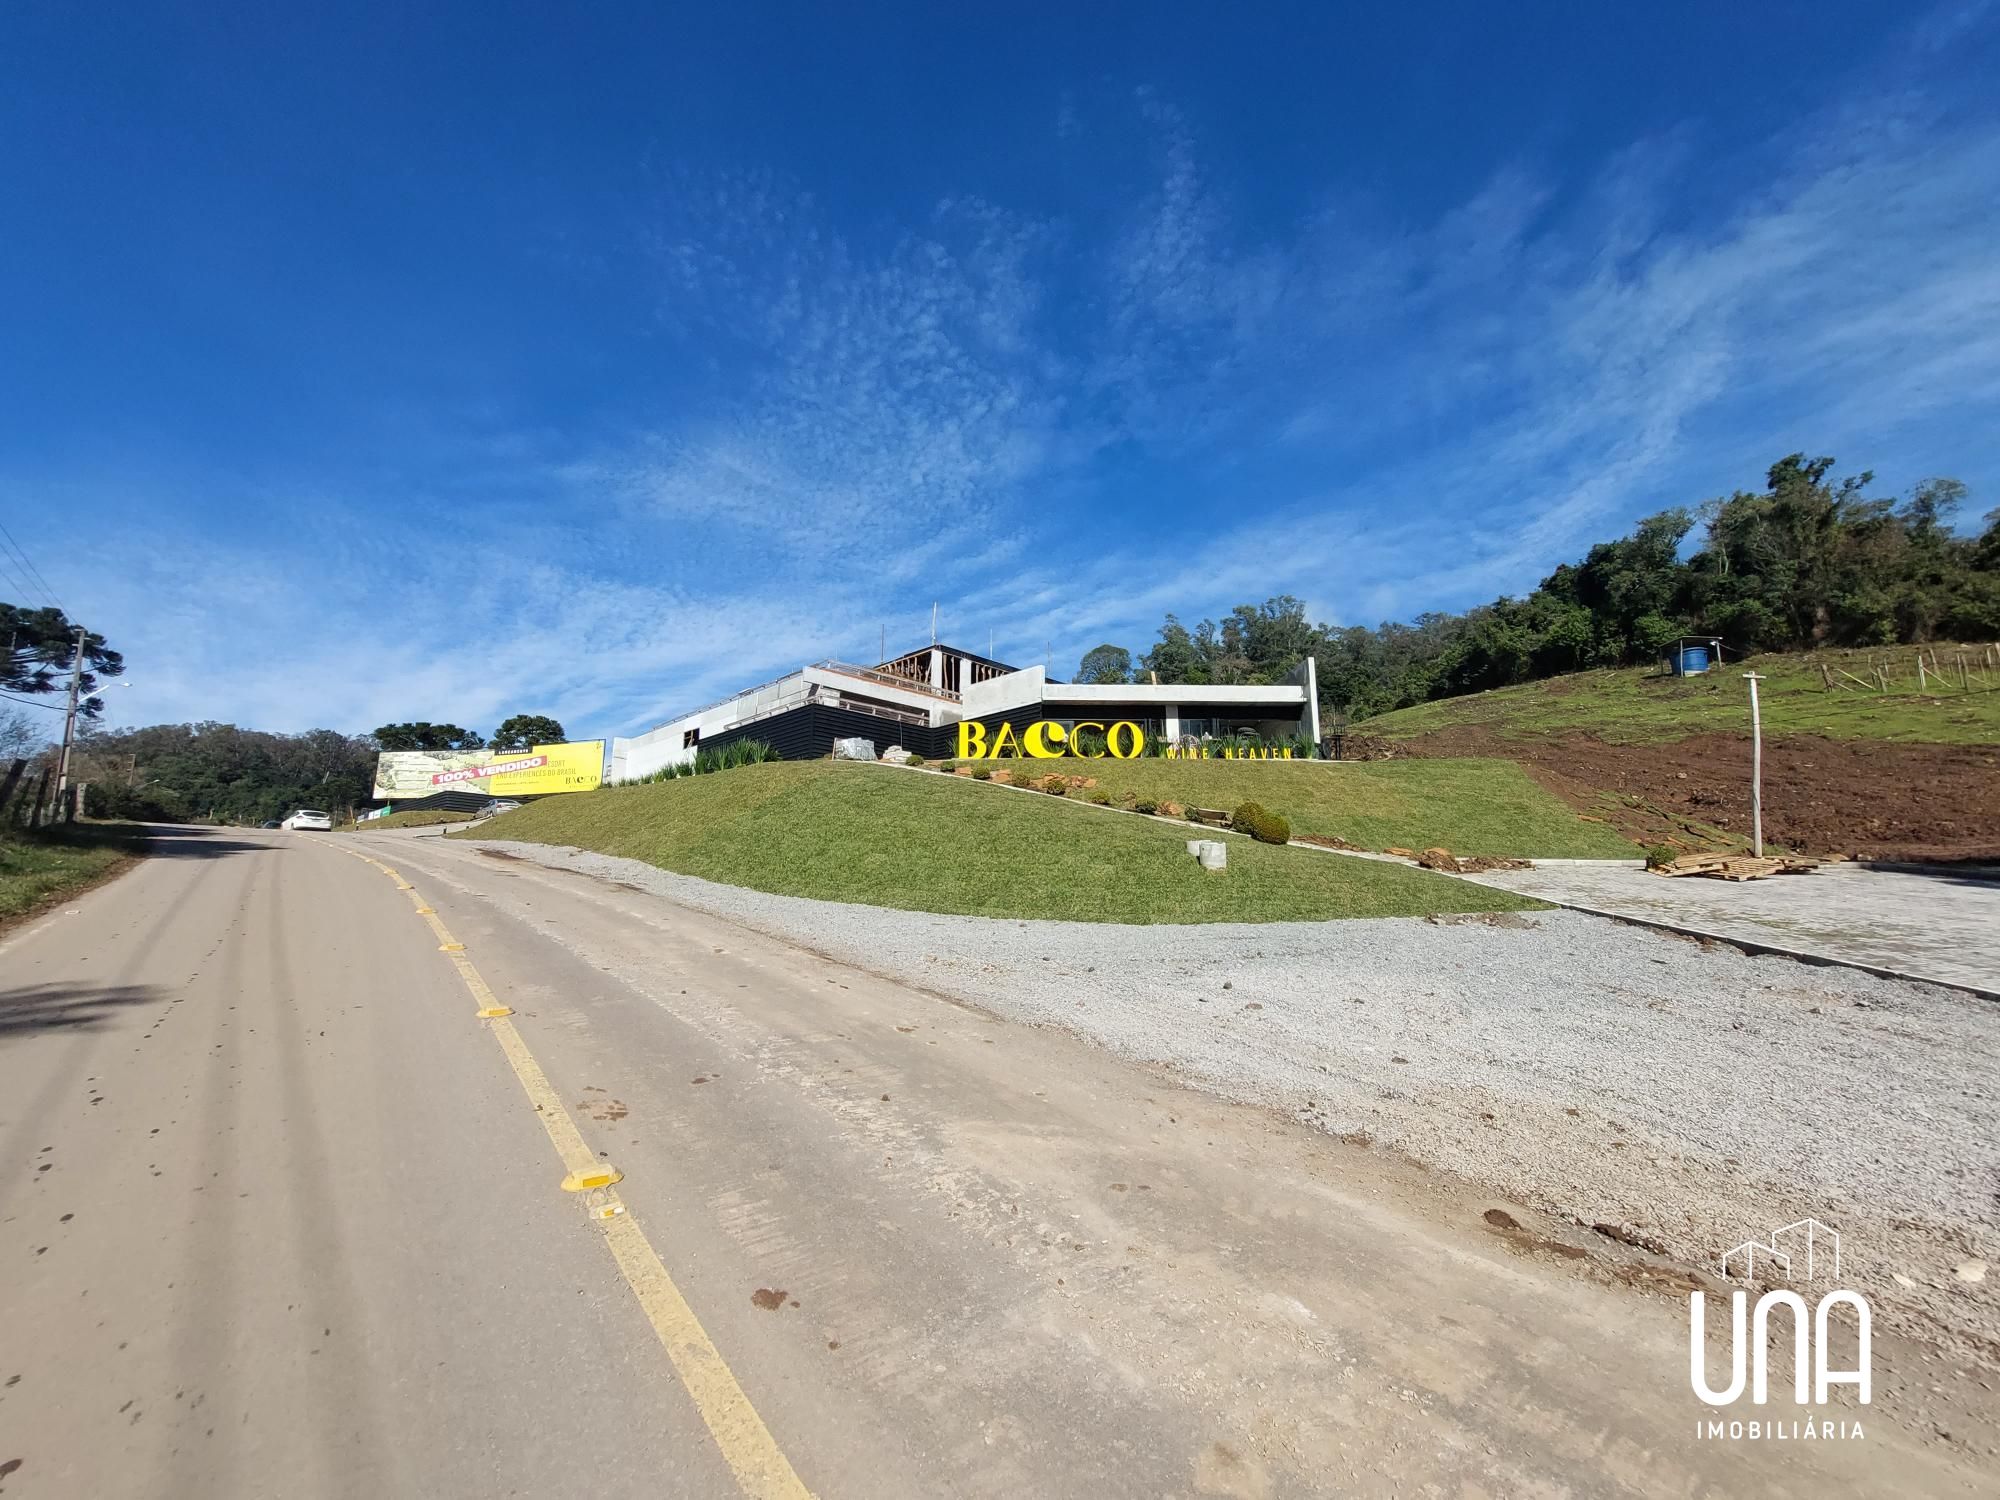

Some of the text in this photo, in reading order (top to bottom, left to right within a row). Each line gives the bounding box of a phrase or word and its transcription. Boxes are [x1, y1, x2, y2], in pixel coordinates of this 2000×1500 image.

[958, 721, 1144, 759] BACCO
[1166, 747, 1292, 760] WINE HEAVEN
[437, 757, 542, 783] 100% VENDIDO
